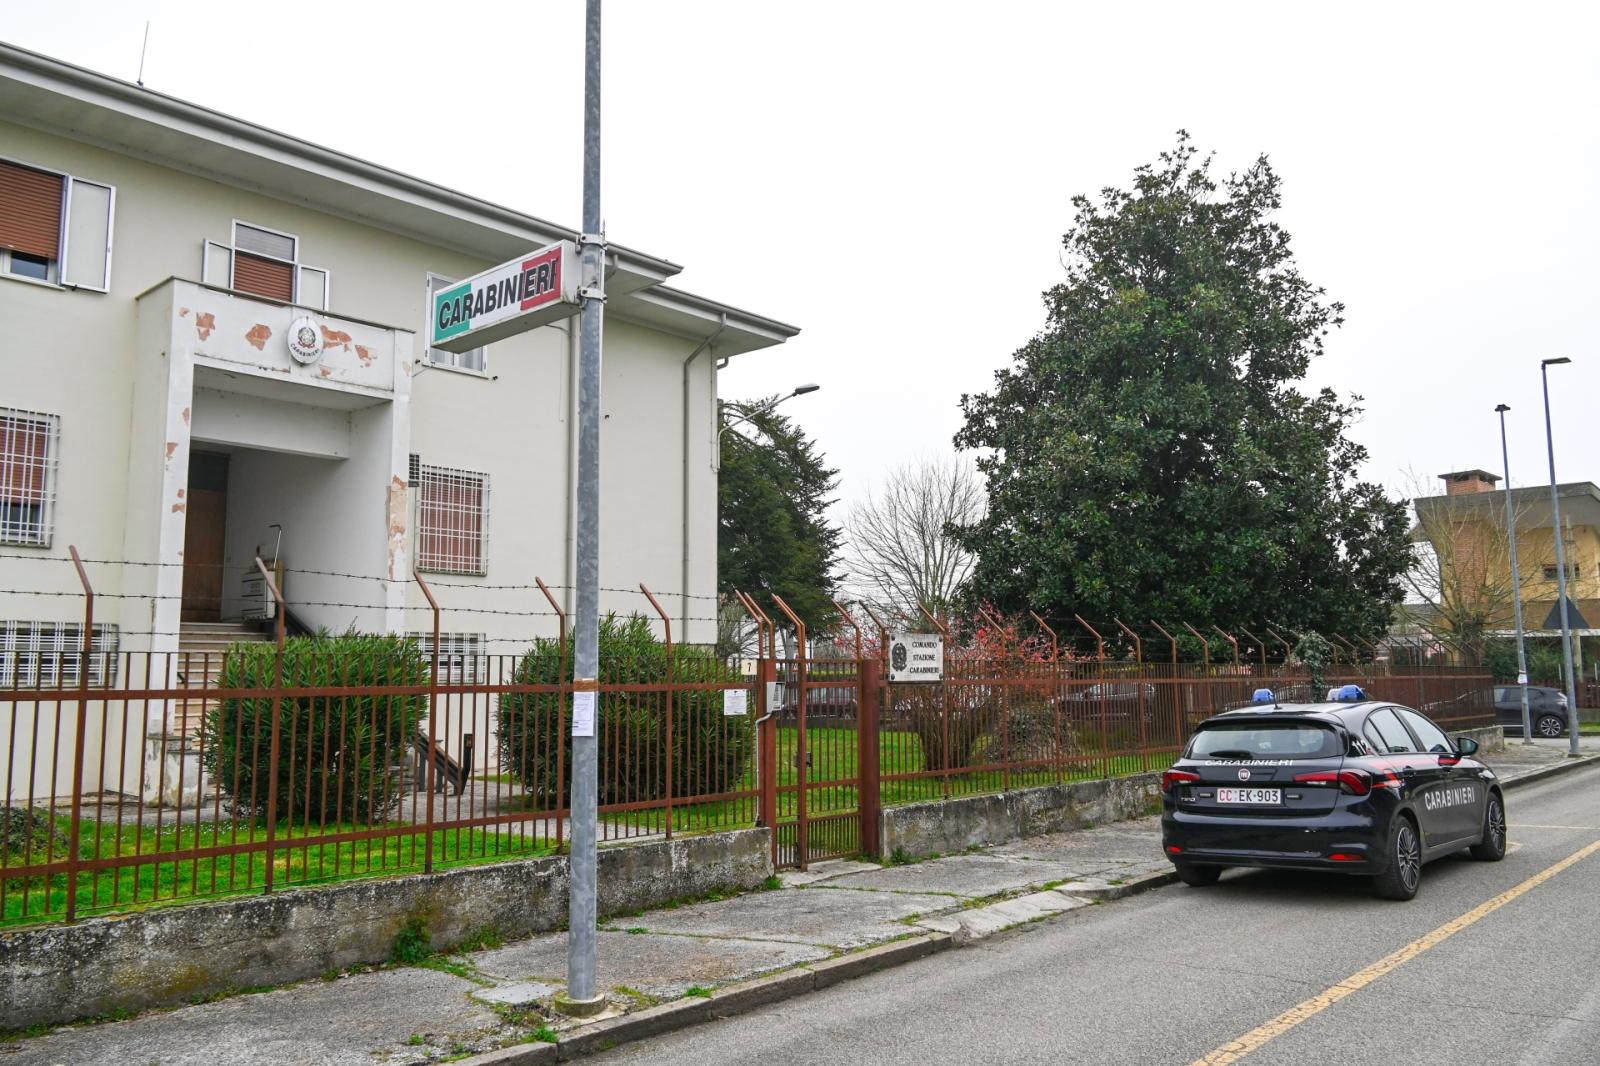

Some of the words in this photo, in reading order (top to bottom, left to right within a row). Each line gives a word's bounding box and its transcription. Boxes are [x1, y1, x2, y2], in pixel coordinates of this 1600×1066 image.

[439, 258, 559, 330] CARABINIERI
[911, 641, 938, 649] COMANDO
[912, 654, 936, 662] STAZIONE
[909, 666, 940, 674] CARABINIERI
[1204, 759, 1295, 767] CARABINIERI
[1424, 786, 1475, 811] CARABINIERI
